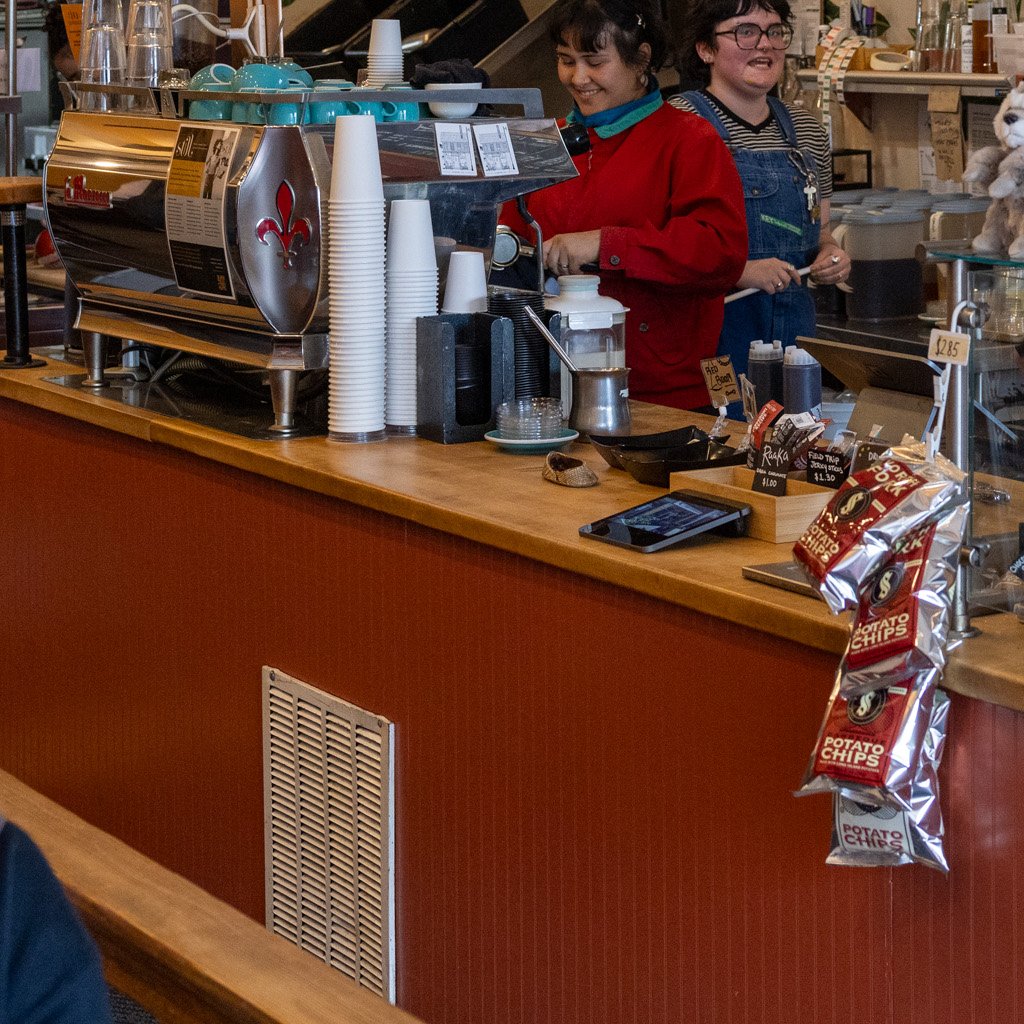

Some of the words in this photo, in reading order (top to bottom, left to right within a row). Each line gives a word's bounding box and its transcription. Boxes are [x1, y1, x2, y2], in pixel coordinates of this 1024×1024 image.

[762, 478, 777, 487] $1.00
[814, 473, 835, 481] $1.30
[823, 737, 884, 755] POTATO
[821, 748, 880, 767] CHIPS
[843, 824, 903, 839] POTATO
[844, 835, 903, 850] CHIPS
